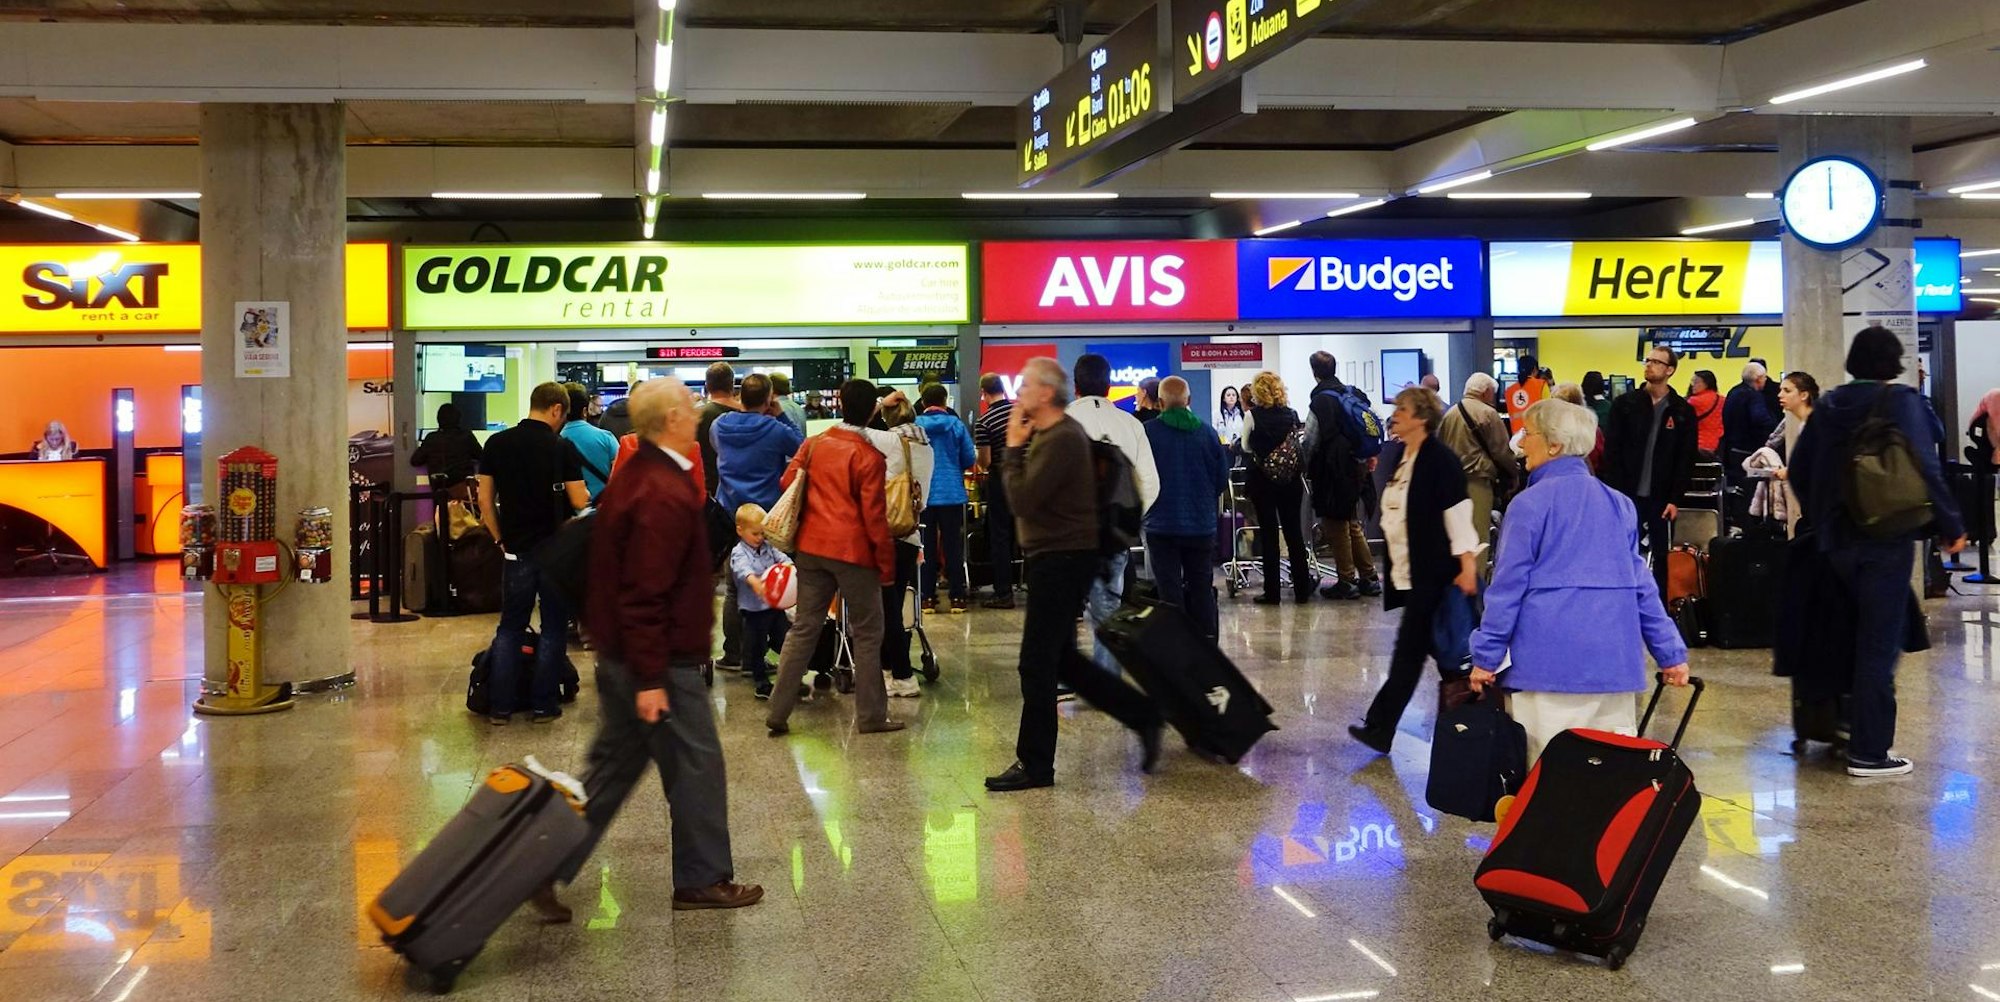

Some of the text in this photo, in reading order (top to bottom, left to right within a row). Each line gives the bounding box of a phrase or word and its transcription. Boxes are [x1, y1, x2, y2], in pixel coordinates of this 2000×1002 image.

[1251, 9, 1288, 47] Aduana
[1091, 50, 1107, 72] Cinta
[1092, 117, 1107, 139] Cinta
[1130, 62, 1151, 116] 06
[852, 259, 960, 271] www.goldcar.com
[416, 256, 668, 294] GOLDCAR
[1039, 255, 1185, 307] AVIS
[1321, 256, 1453, 302] Budget
[1588, 257, 1724, 299] Hertz
[82, 313, 160, 321] rent a car
[562, 298, 669, 317] rental
[1690, 329, 1708, 339] Club
[659, 348, 723, 357] SIN PERDERSE
[905, 353, 950, 361] EXPRESS
[903, 361, 948, 370] SERVICE
[1110, 366, 1158, 385] udget
